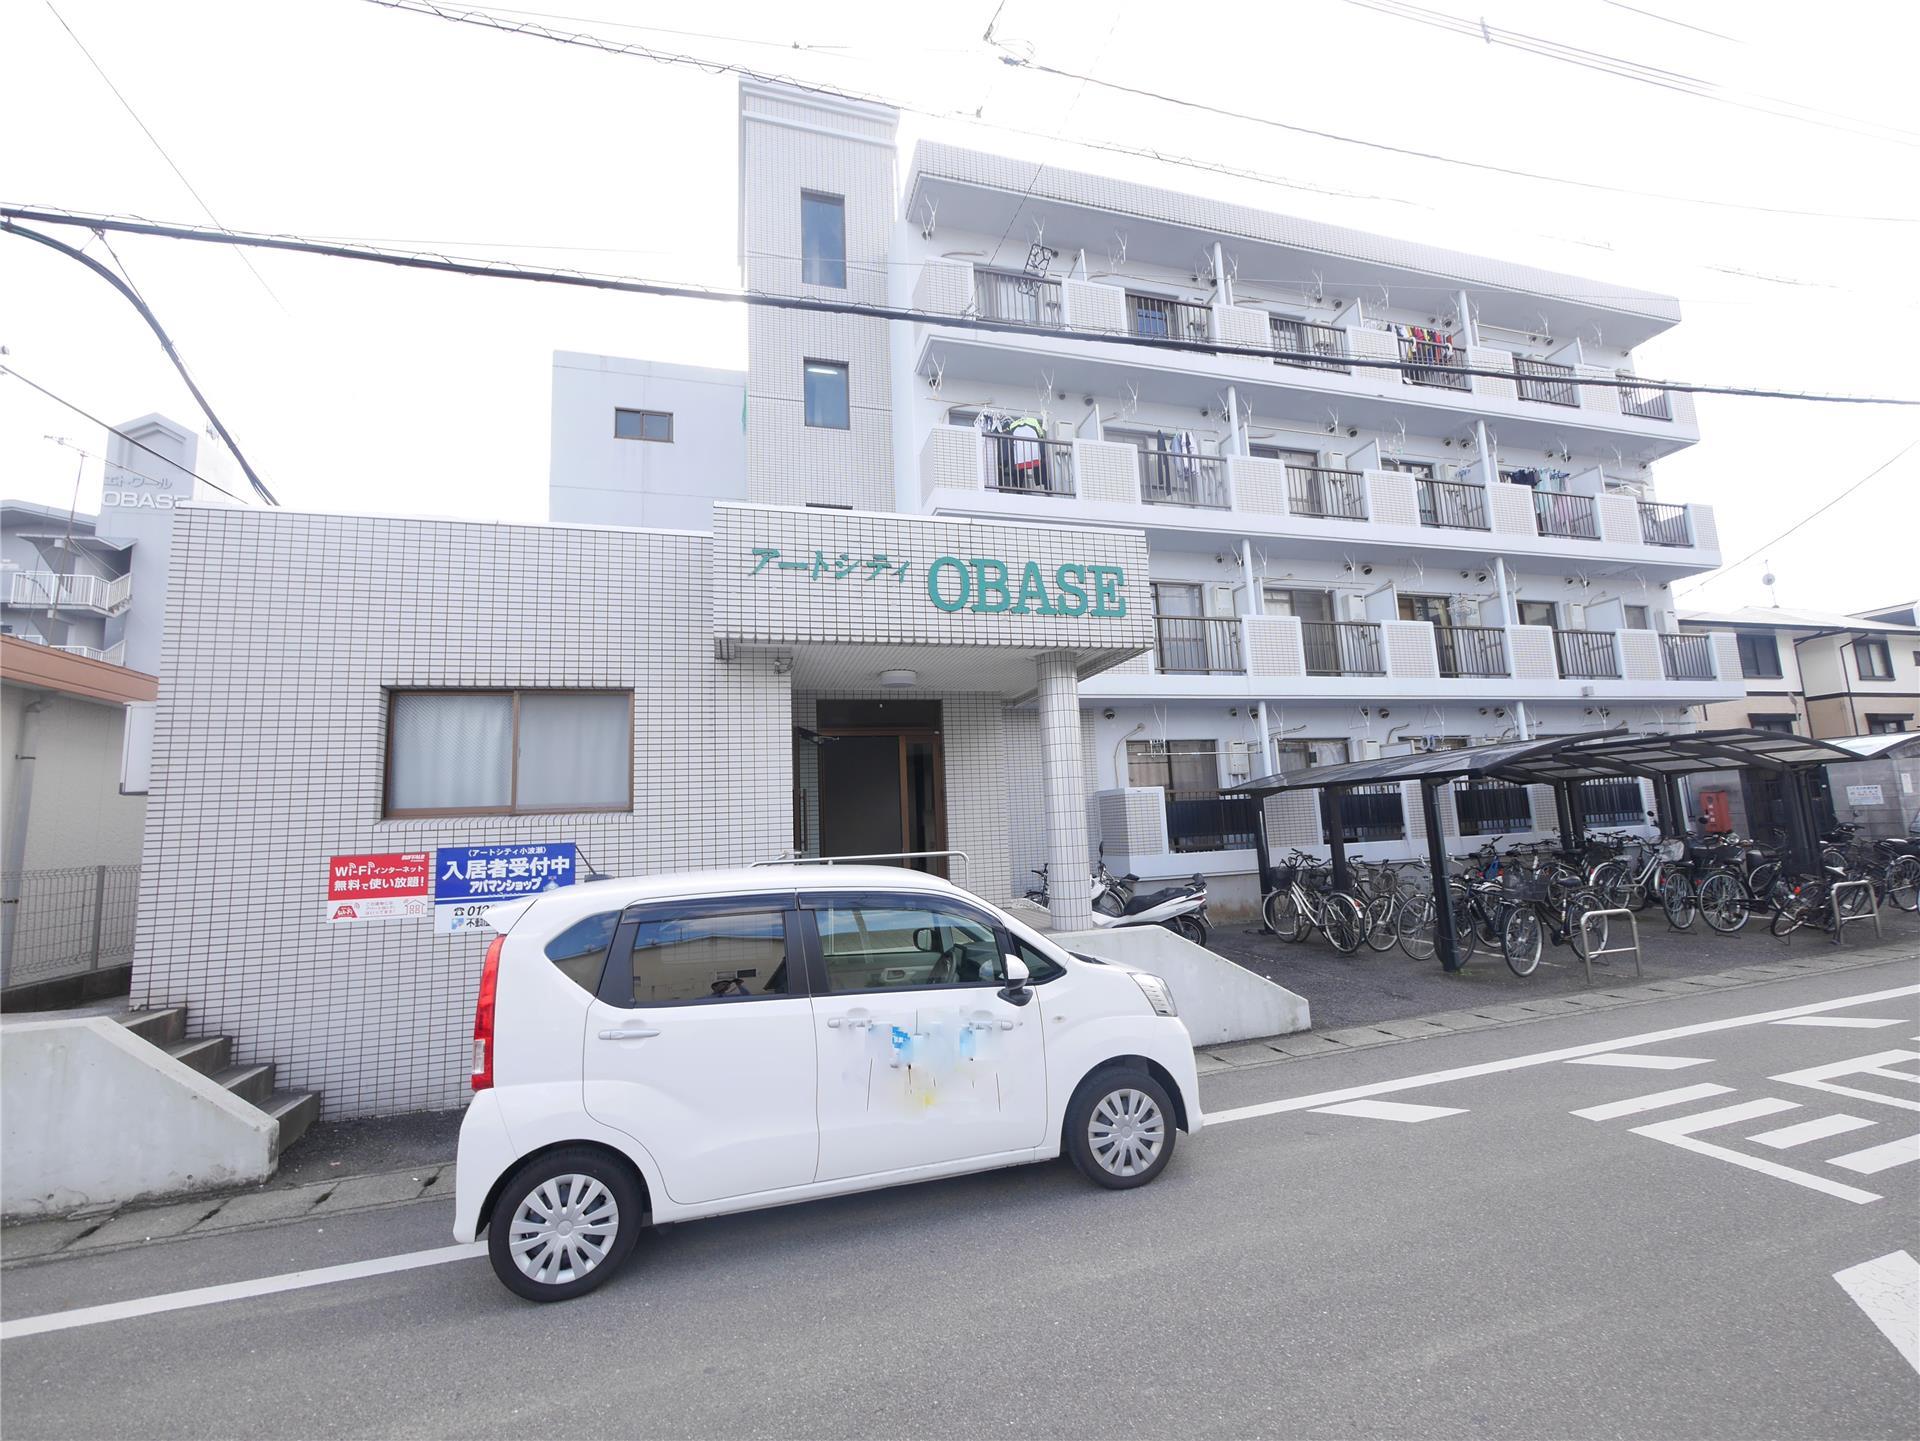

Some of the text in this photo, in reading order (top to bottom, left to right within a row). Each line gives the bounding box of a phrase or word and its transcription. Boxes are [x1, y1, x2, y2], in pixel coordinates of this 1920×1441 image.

[748, 548, 1127, 618] アートシティ OBASE
[441, 855, 571, 881] 入居者受付中
[468, 877, 543, 894] アパマンショップ
